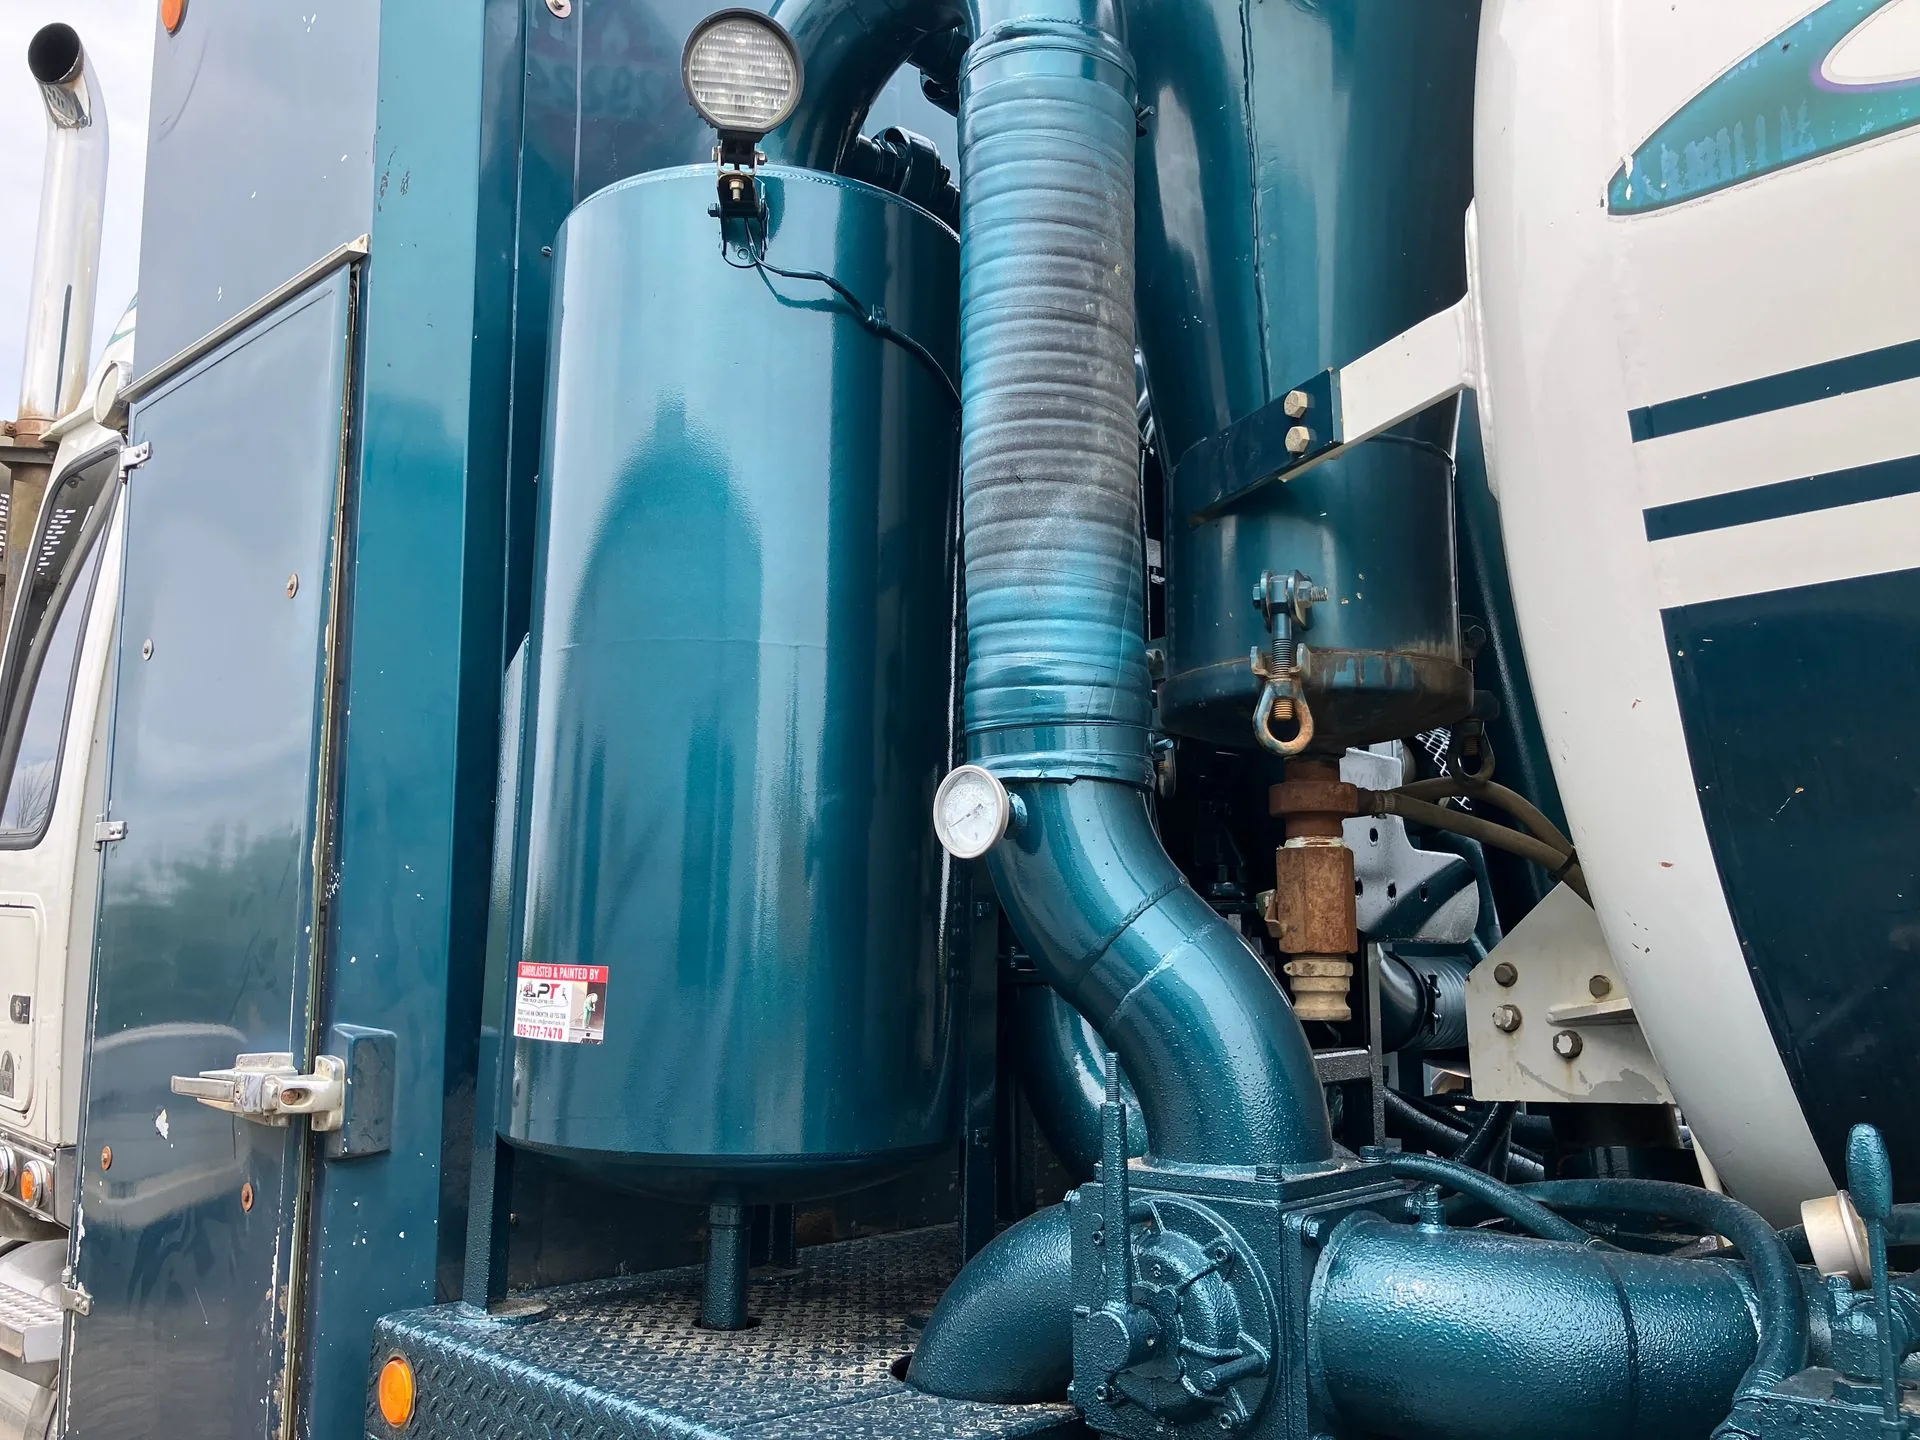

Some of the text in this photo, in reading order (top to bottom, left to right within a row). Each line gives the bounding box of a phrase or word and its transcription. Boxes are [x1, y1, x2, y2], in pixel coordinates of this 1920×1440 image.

[521, 965, 600, 980] SANDBLASTED & PAINTED BY
